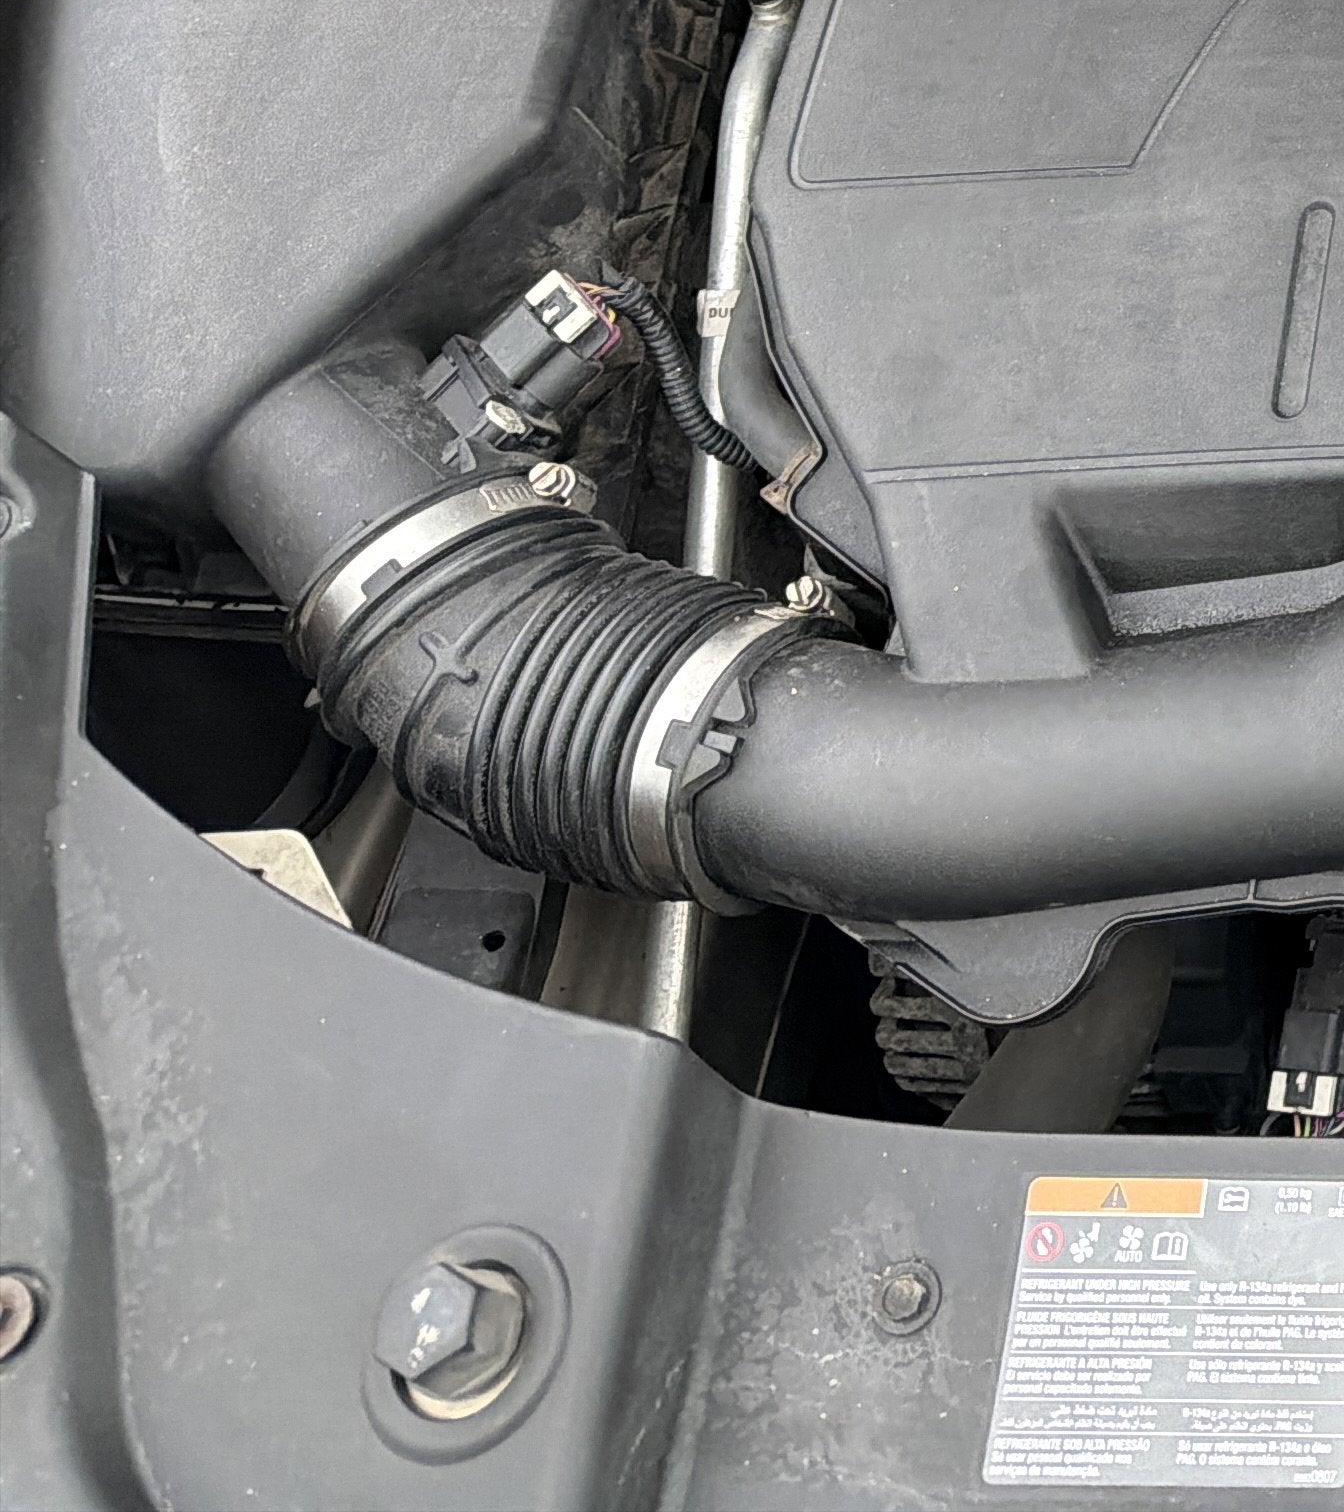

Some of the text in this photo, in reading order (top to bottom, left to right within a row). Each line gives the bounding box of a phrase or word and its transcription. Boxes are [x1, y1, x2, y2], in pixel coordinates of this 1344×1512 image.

[1113, 1250, 1143, 1263] AUTO
[1020, 1278, 1191, 1291] REFRIGERANT UNDER HIGH PRESSURE
[1199, 1281, 1217, 1292] Use
[1218, 1281, 1237, 1294] only
[1239, 1281, 1272, 1292] R-134a
[1272, 1282, 1320, 1294] refrigerant
[1320, 1282, 1338, 1293] and
[1019, 1291, 1053, 1302] Service
[1054, 1292, 1065, 1304] by
[1066, 1292, 1105, 1304] qualified
[1106, 1293, 1150, 1304] personnel
[1213, 1294, 1247, 1306] System
[1248, 1294, 1286, 1305] contains
[1112, 1312, 1137, 1324] SOUS
[1138, 1312, 1170, 1324] HAUTE
[1276, 1315, 1287, 1326] le
[1194, 1326, 1228, 1337] R-134a
[1228, 1326, 1239, 1337] et
[1240, 1327, 1252, 1338] de
[1304, 1328, 1316, 1338] Le
[1007, 1356, 1077, 1368] REFRIGERANTE
[1078, 1357, 1086, 1368] A
[1086, 1357, 1110, 1368] ALTA
[1189, 1359, 1206, 1370] Use
[1228, 1360, 1281, 1372] refrigerante
[1282, 1360, 1316, 1371] R-134a
[1016, 1370, 1052, 1381] servicio
[1052, 1371, 1076, 1381] debe
[1077, 1372, 1092, 1381] ser
[1092, 1372, 1134, 1382] realizado
[1135, 1372, 1152, 1383] por
[1220, 1373, 1256, 1383] sistema
[1257, 1373, 1296, 1384] contiene
[1003, 1383, 1042, 1395] personal
[1044, 1384, 1092, 1395] capacitado
[994, 1438, 1062, 1450] REFRIGERANTE
[1062, 1438, 1083, 1450] SOB
[1083, 1439, 1106, 1451] ALTA
[1214, 1441, 1268, 1454] refrigerante
[1268, 1441, 1302, 1453] R-134a
